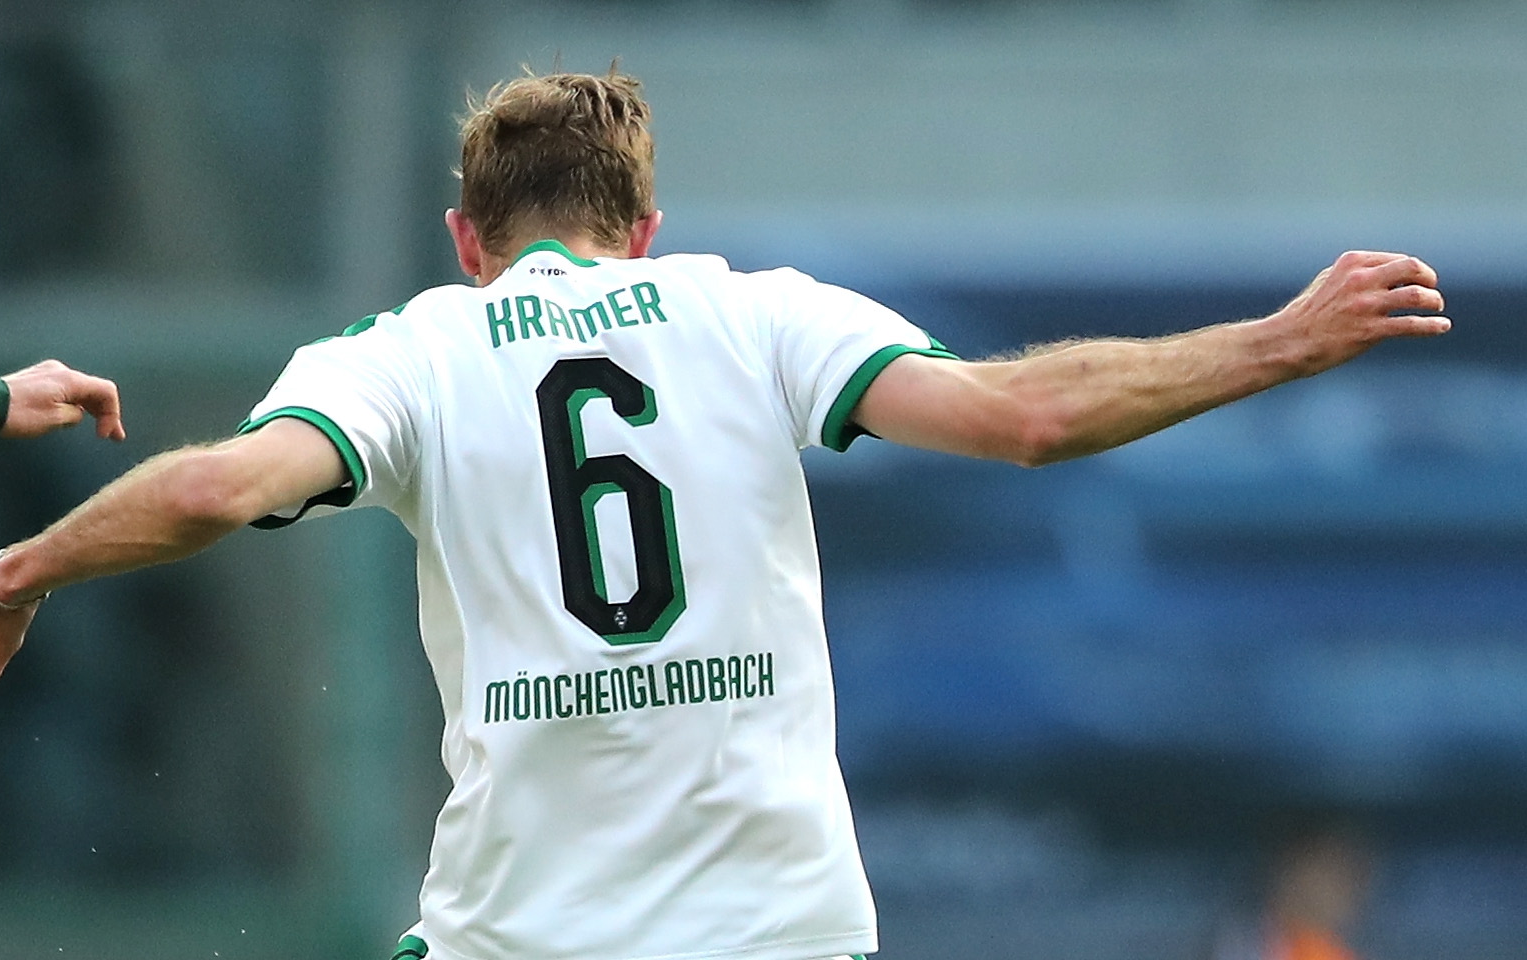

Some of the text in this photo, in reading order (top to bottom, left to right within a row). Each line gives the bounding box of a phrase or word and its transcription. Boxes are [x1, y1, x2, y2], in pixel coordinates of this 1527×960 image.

[485, 281, 668, 349] KRAMER
[535, 356, 688, 647] 6
[483, 652, 775, 724] MÖNCHENGLADBACH
